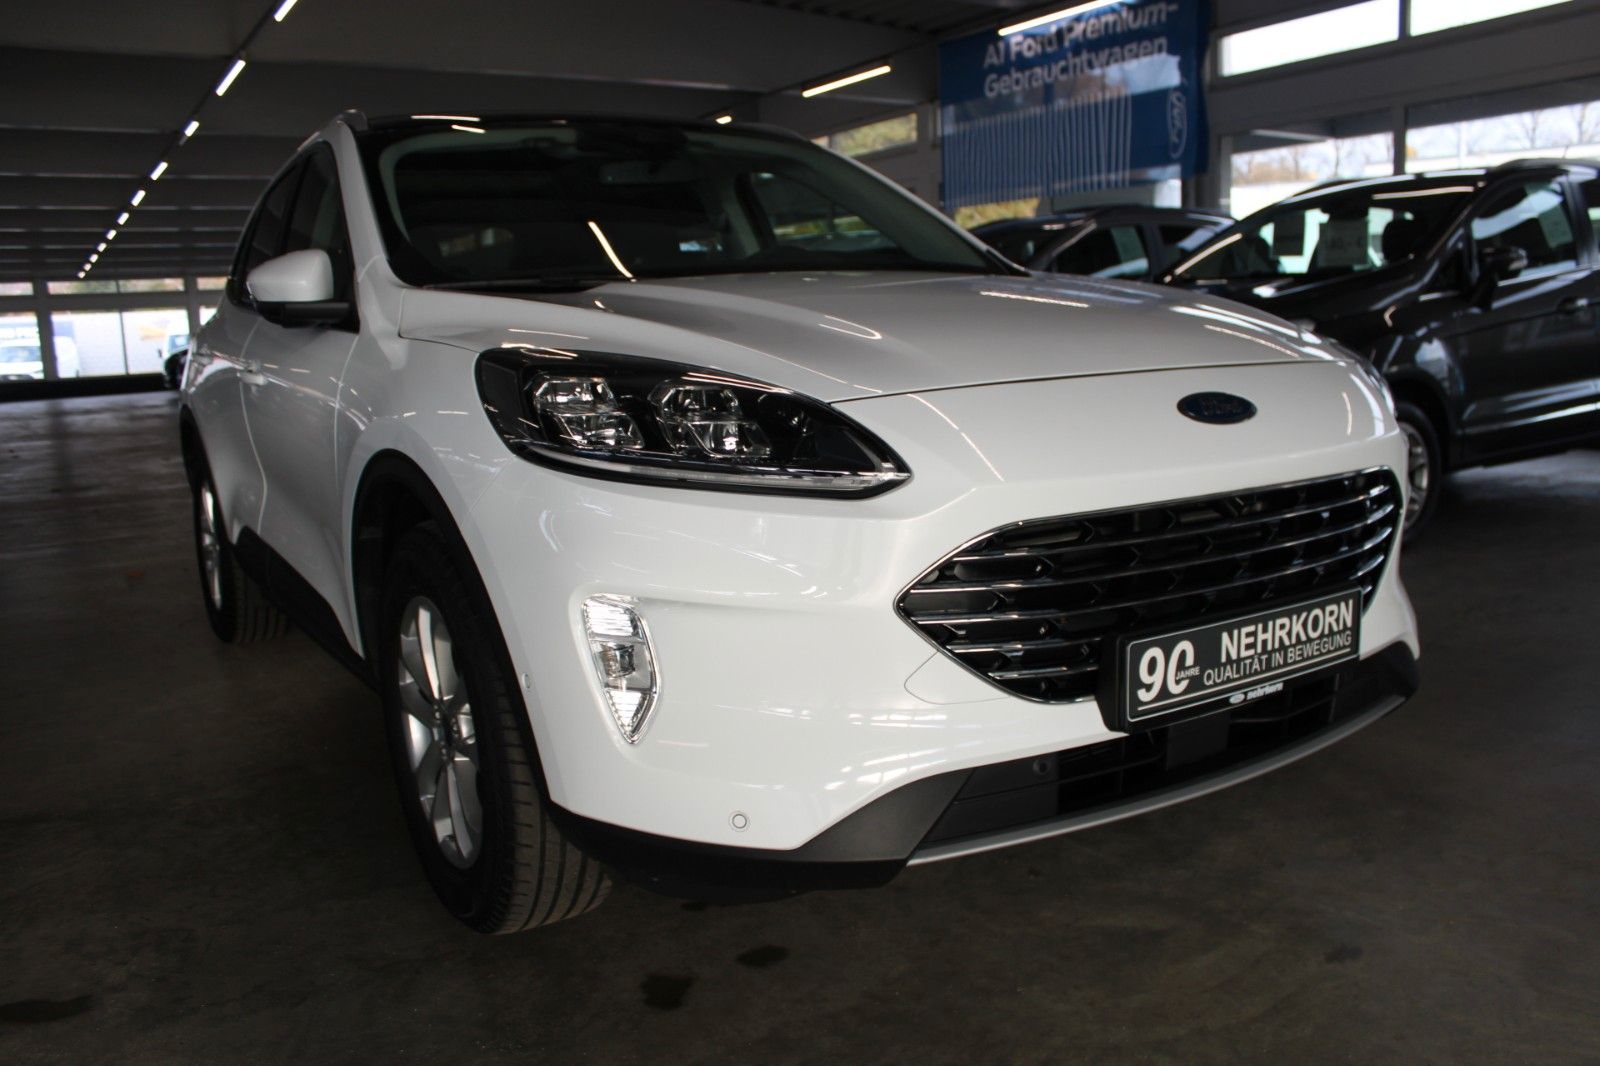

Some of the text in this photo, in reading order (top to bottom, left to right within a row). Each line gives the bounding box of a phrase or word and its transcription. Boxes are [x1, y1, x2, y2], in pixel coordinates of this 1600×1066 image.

[1009, 25, 1059, 60] Ford
[1063, 2, 1180, 47] Premium-
[983, 36, 1168, 98] Gebrauchtwagen
[1203, 631, 1353, 687] QUALITÄT IN BEWEGUNG
[1220, 599, 1354, 664] NEHRKORN
[1136, 639, 1195, 703] 90
[1175, 665, 1201, 681] JAHRE
